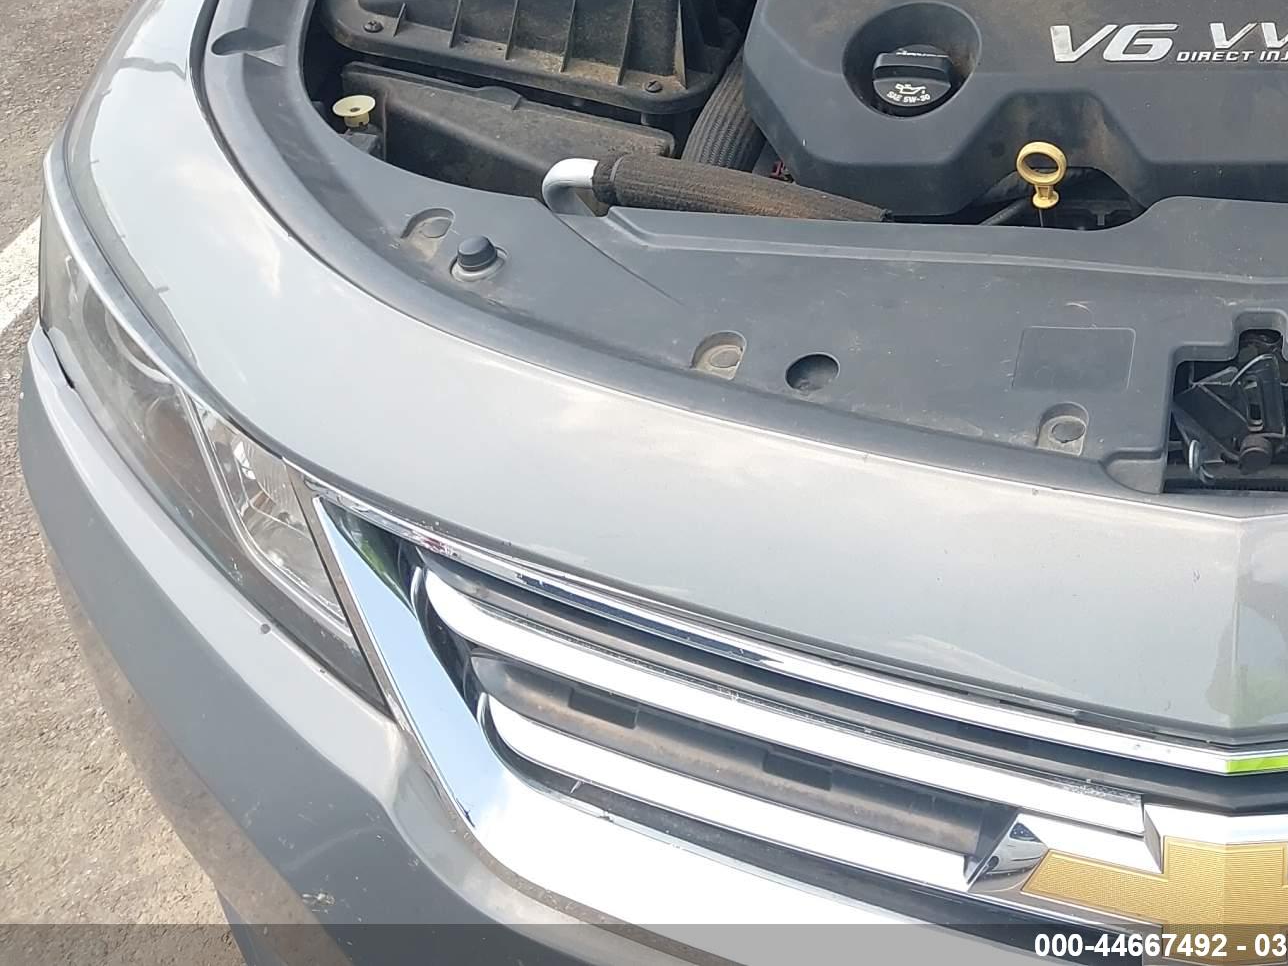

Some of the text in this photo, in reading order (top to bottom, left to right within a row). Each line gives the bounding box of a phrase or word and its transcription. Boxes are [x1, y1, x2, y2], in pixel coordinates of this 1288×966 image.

[1050, 24, 1179, 63] V6
[1176, 50, 1254, 63] DIRECT
[886, 90, 931, 104] SAE 5W-30
